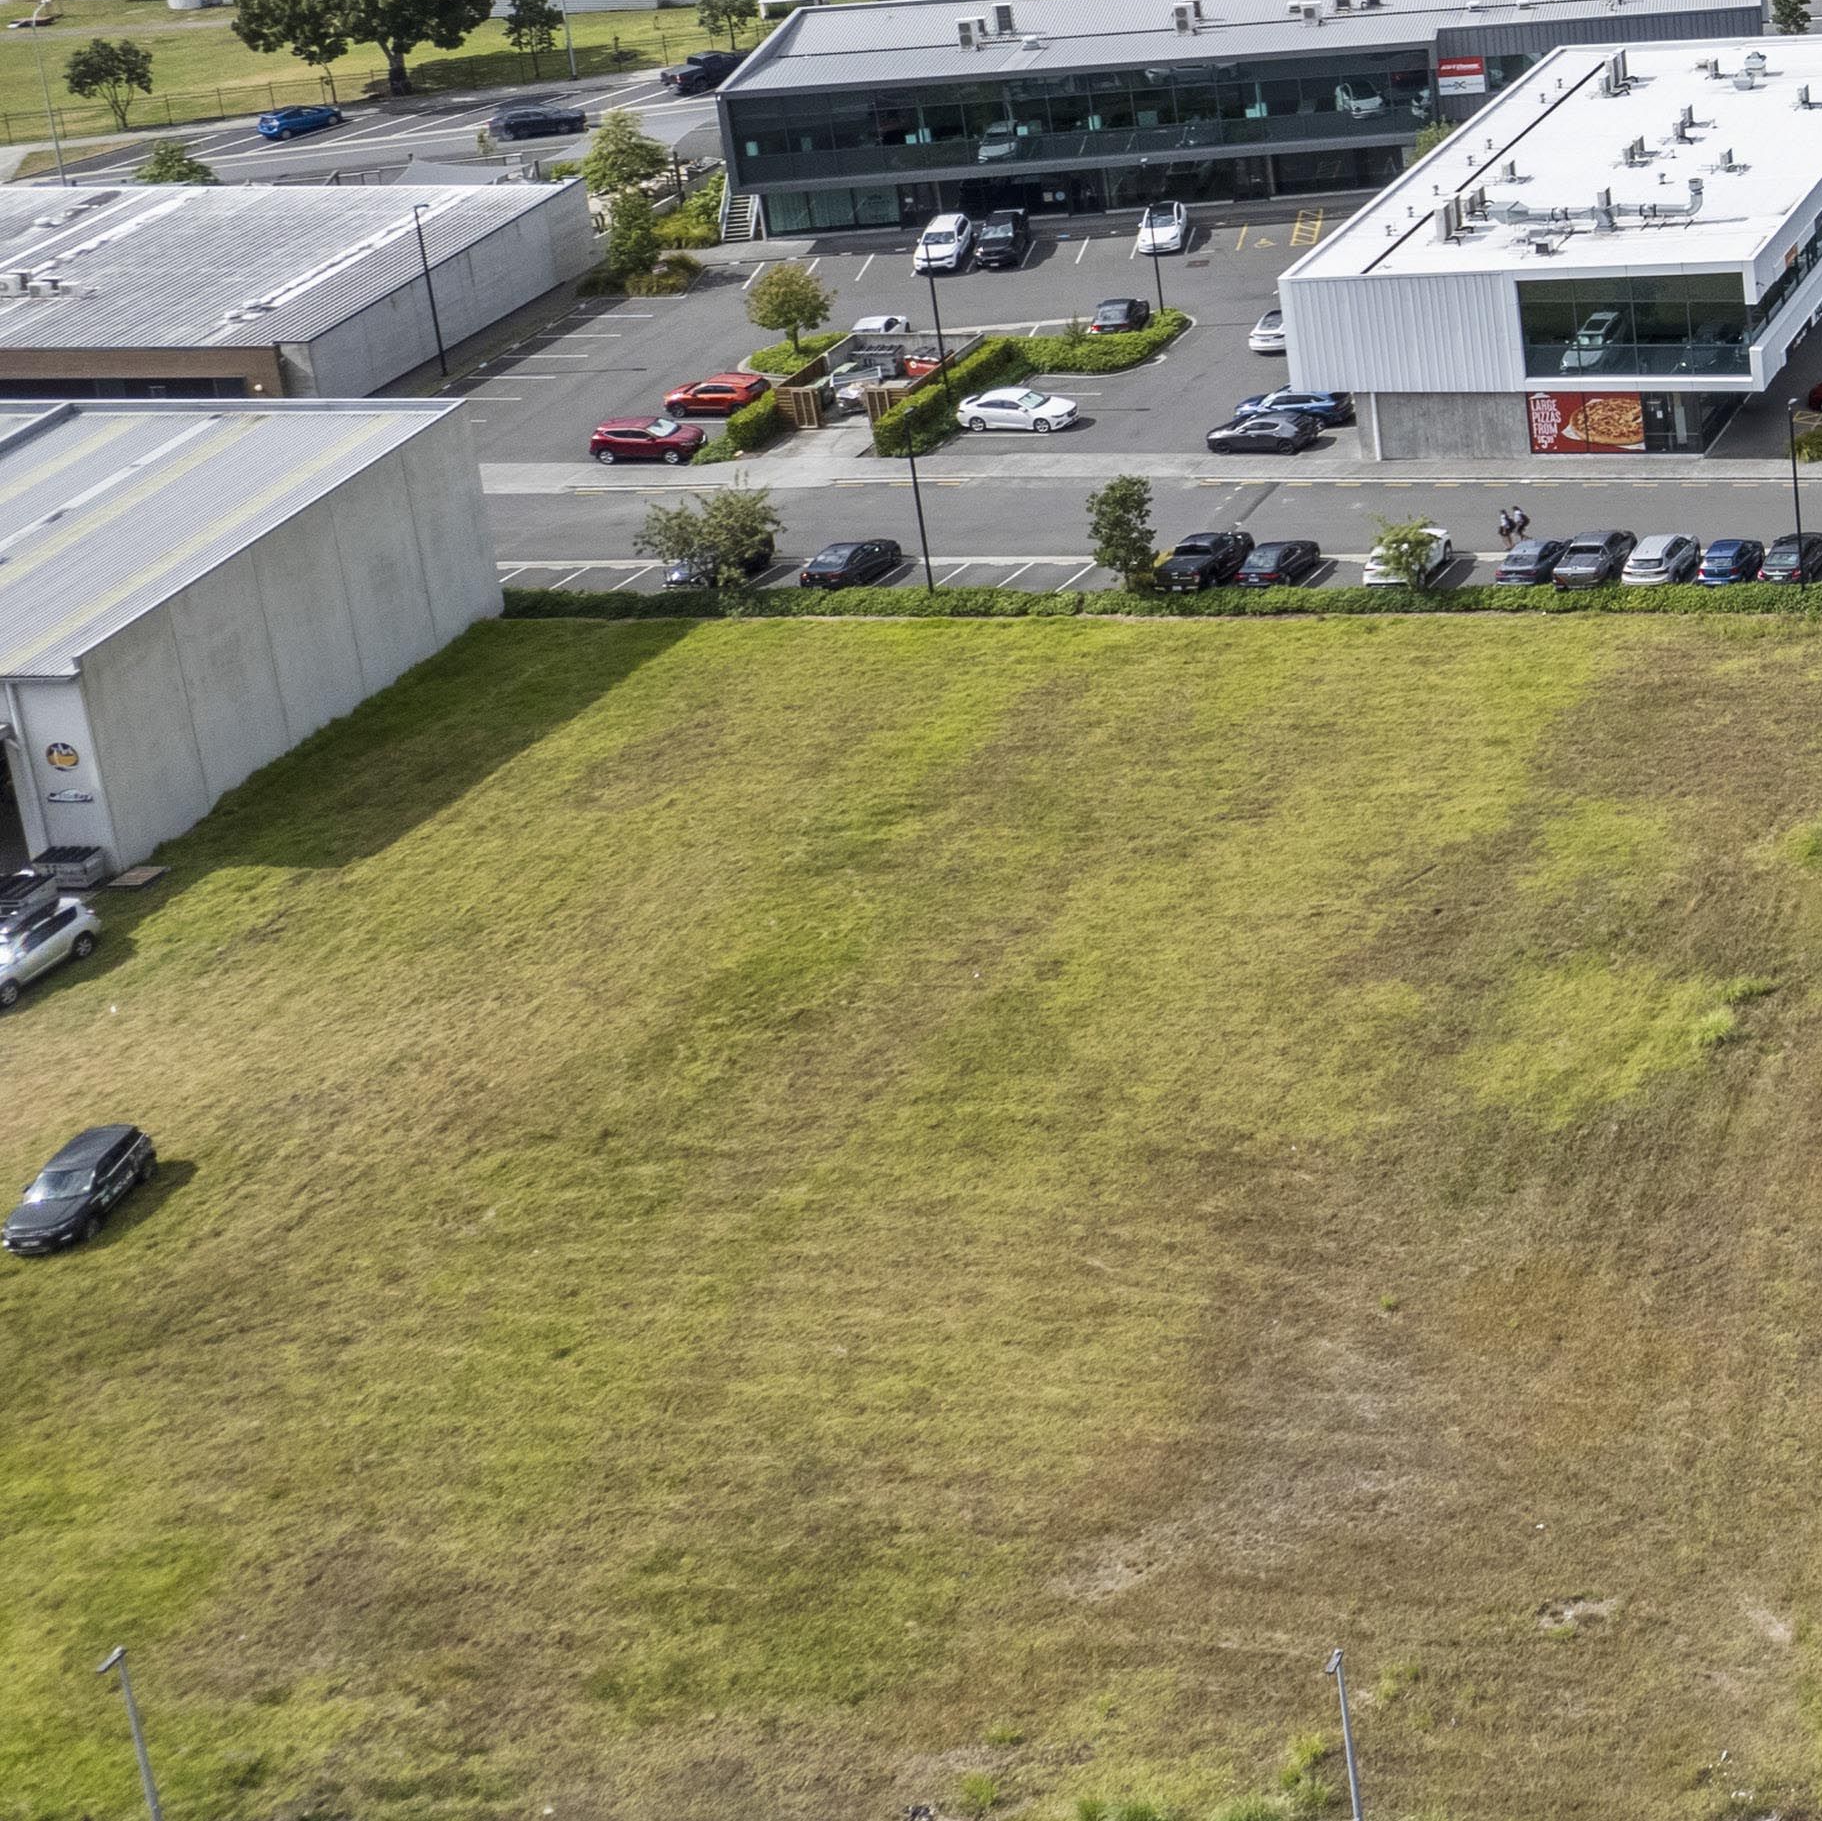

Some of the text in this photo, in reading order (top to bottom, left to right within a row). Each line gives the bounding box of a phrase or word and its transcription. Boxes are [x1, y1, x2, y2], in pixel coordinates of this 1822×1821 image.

[1530, 399, 1557, 411] LARGE
[1532, 411, 1561, 423] PIZZAS
[1533, 423, 1558, 438] FROM
